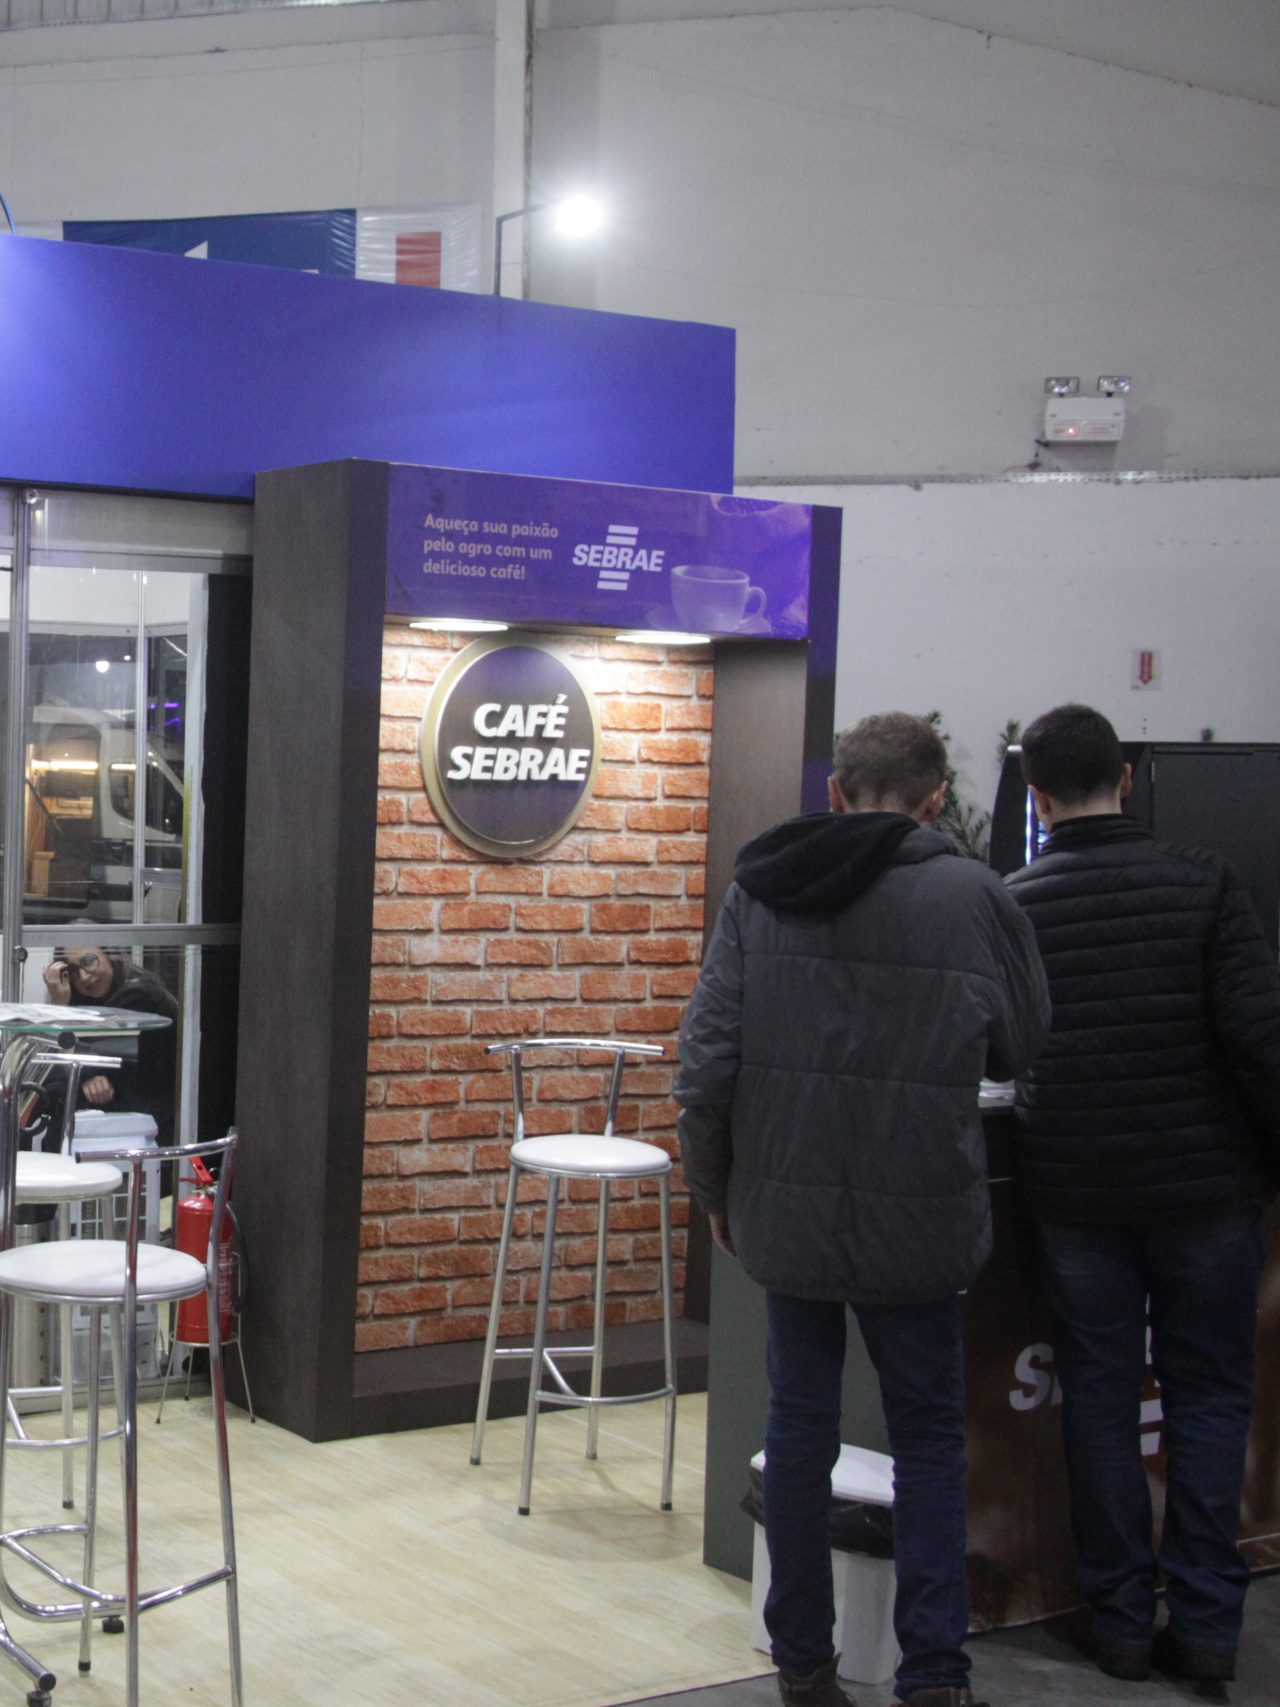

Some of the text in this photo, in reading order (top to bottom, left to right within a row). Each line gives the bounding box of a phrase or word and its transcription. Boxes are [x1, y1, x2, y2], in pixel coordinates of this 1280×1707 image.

[423, 513, 559, 538] Aqueça sua paixão
[423, 536, 553, 560] pelo agro com um
[572, 543, 665, 572] SEBRAE
[422, 558, 526, 580] delicioso café!
[473, 693, 570, 739] CAFÉ
[446, 745, 592, 782] SEBRAE
